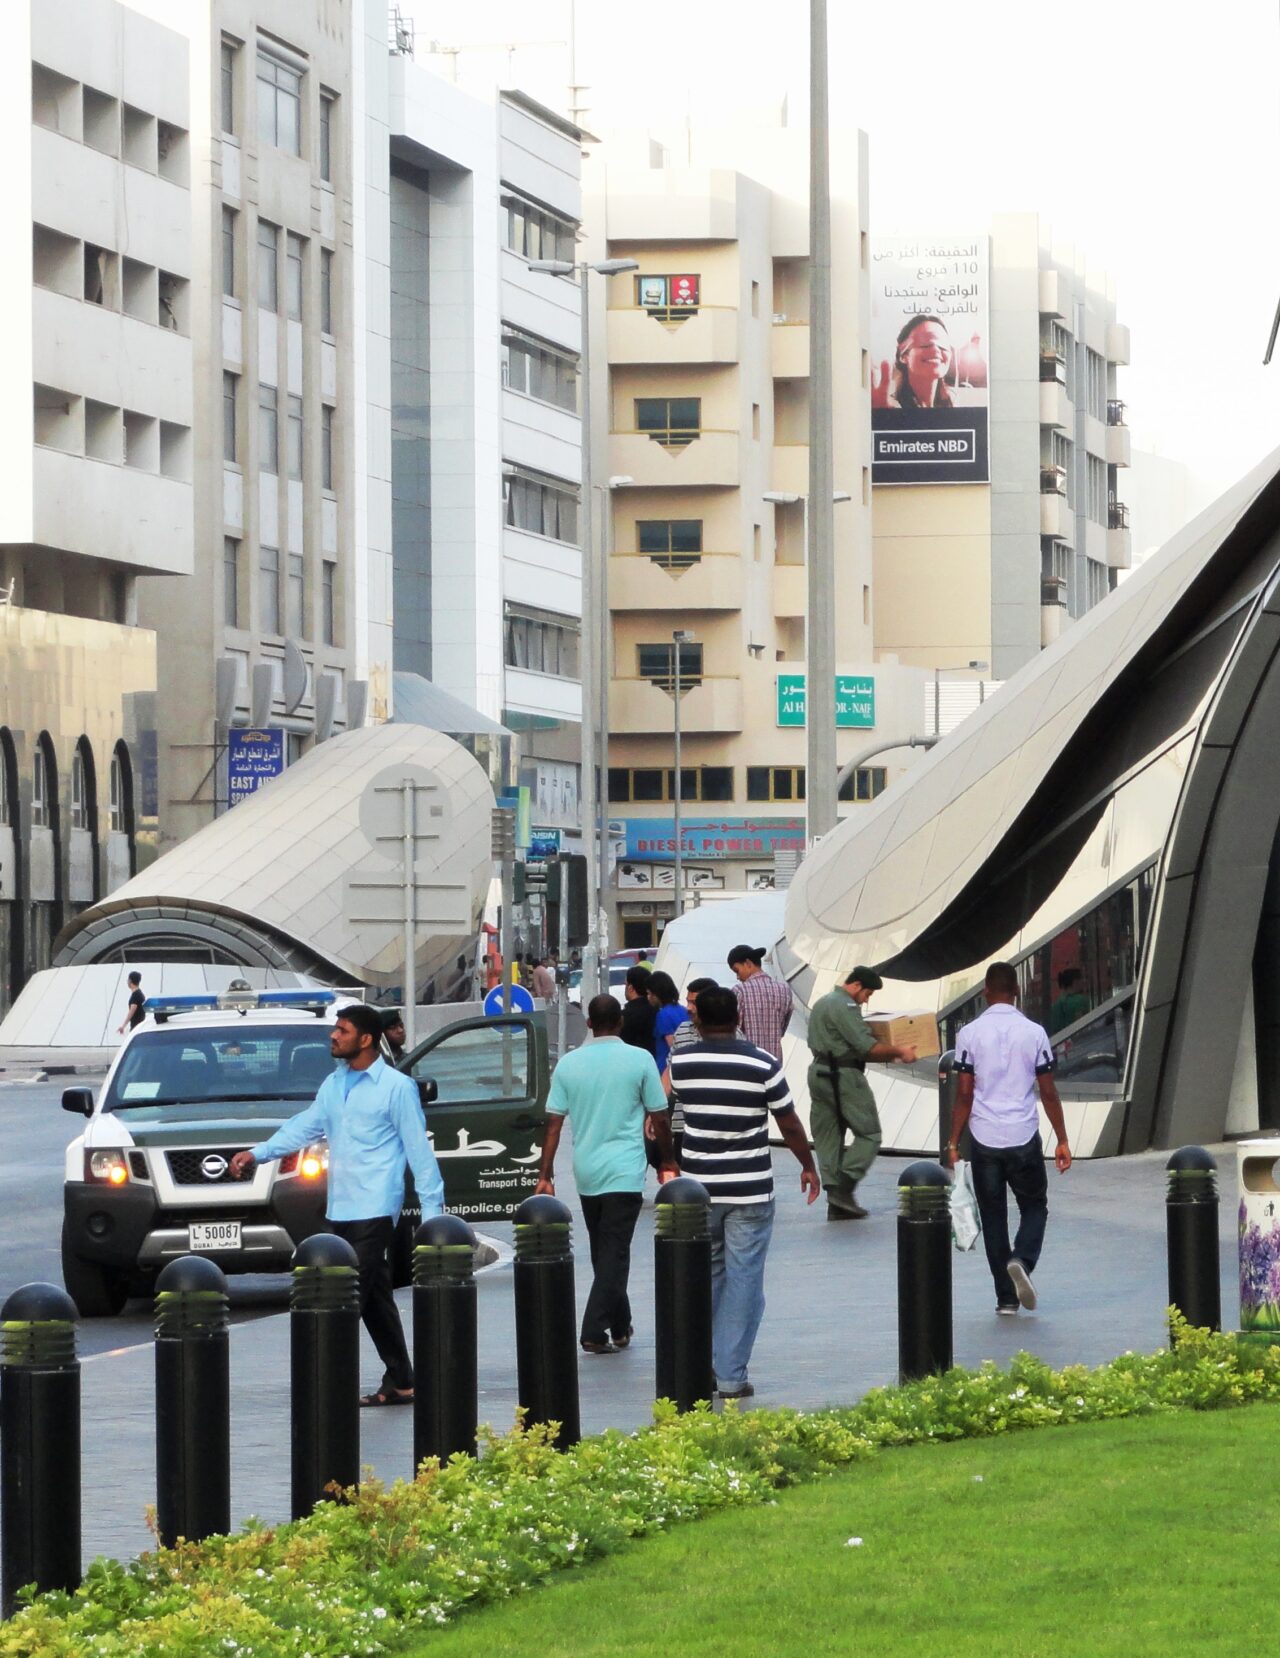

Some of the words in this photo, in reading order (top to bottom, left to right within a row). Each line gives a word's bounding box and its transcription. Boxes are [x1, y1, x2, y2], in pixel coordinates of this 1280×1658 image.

[917, 264, 947, 280] فروع
[954, 262, 978, 274] 110
[884, 285, 928, 300] ستجدنا
[934, 284, 978, 302] الواقع:
[903, 302, 931, 315] منك
[936, 301, 978, 316] بالقرب
[879, 440, 936, 453] Emirates
[938, 440, 968, 453] NBD
[840, 680, 872, 698] بناية
[231, 776, 255, 789] EAST
[702, 838, 763, 851] POWER
[478, 1178, 517, 1189] Transport
[193, 1227, 200, 1240] L
[205, 1225, 239, 1240] 50087
